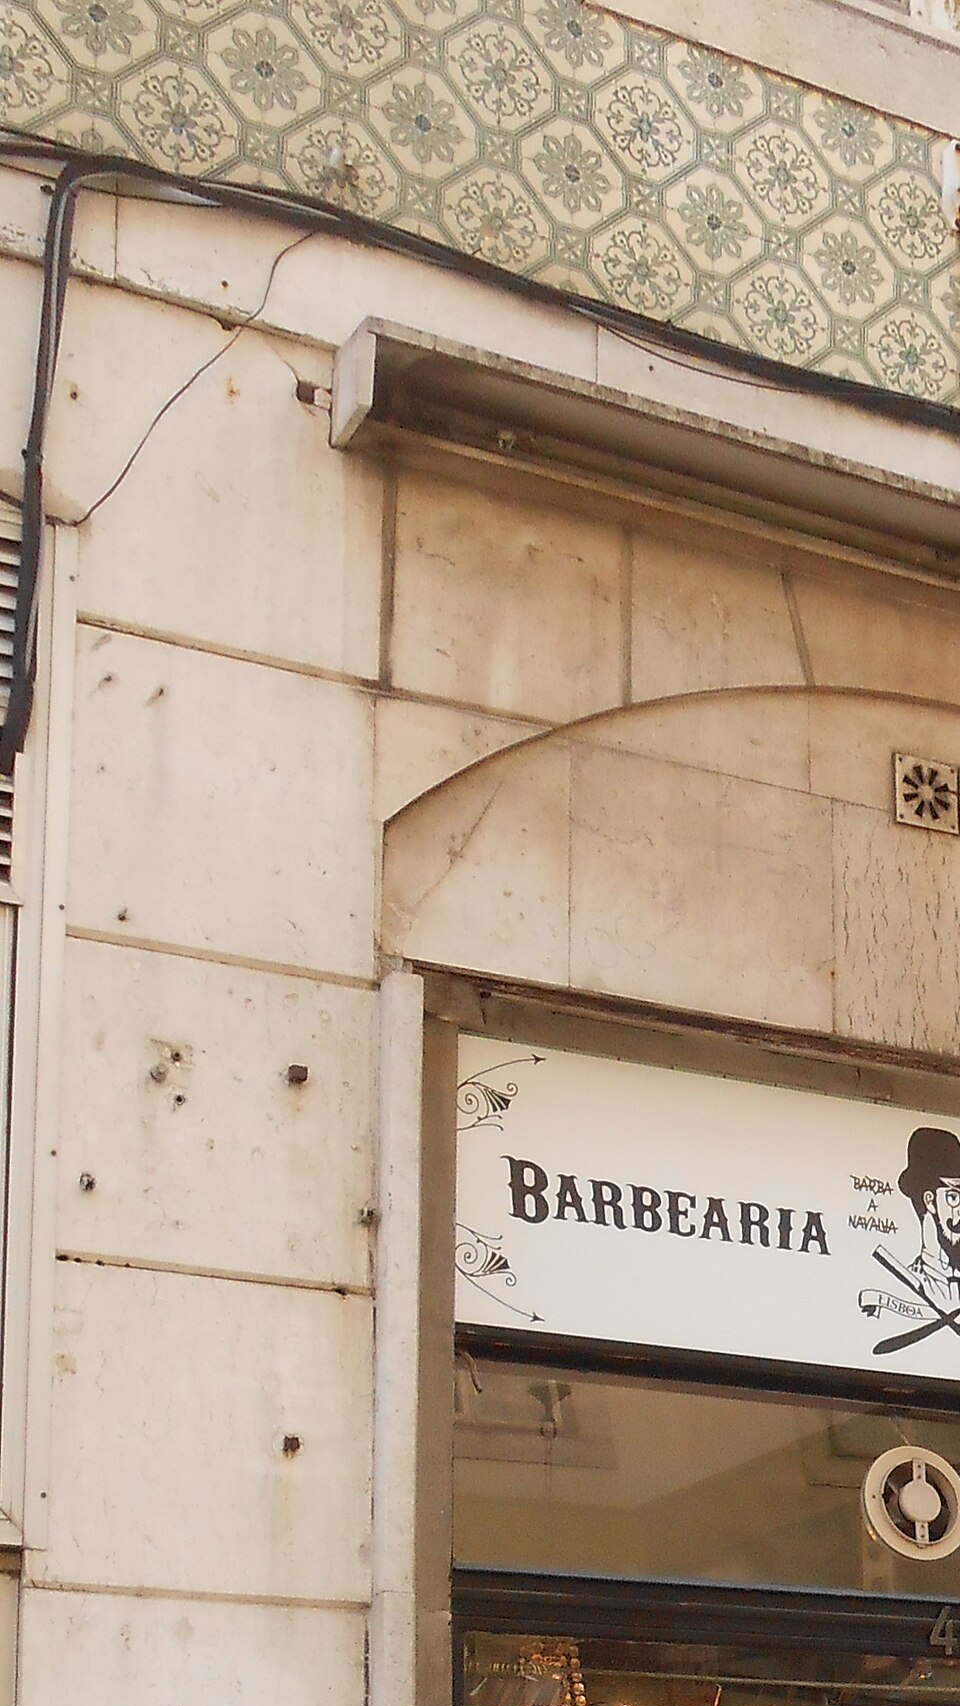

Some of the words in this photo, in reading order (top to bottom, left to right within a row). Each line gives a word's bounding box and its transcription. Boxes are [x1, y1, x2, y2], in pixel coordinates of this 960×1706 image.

[850, 1174, 894, 1196] BARBA
[500, 1154, 831, 1256] BARBEARIA
[867, 1198, 878, 1213] A
[848, 1215, 899, 1235] NAVALHA
[878, 1294, 924, 1318] LISBOA
